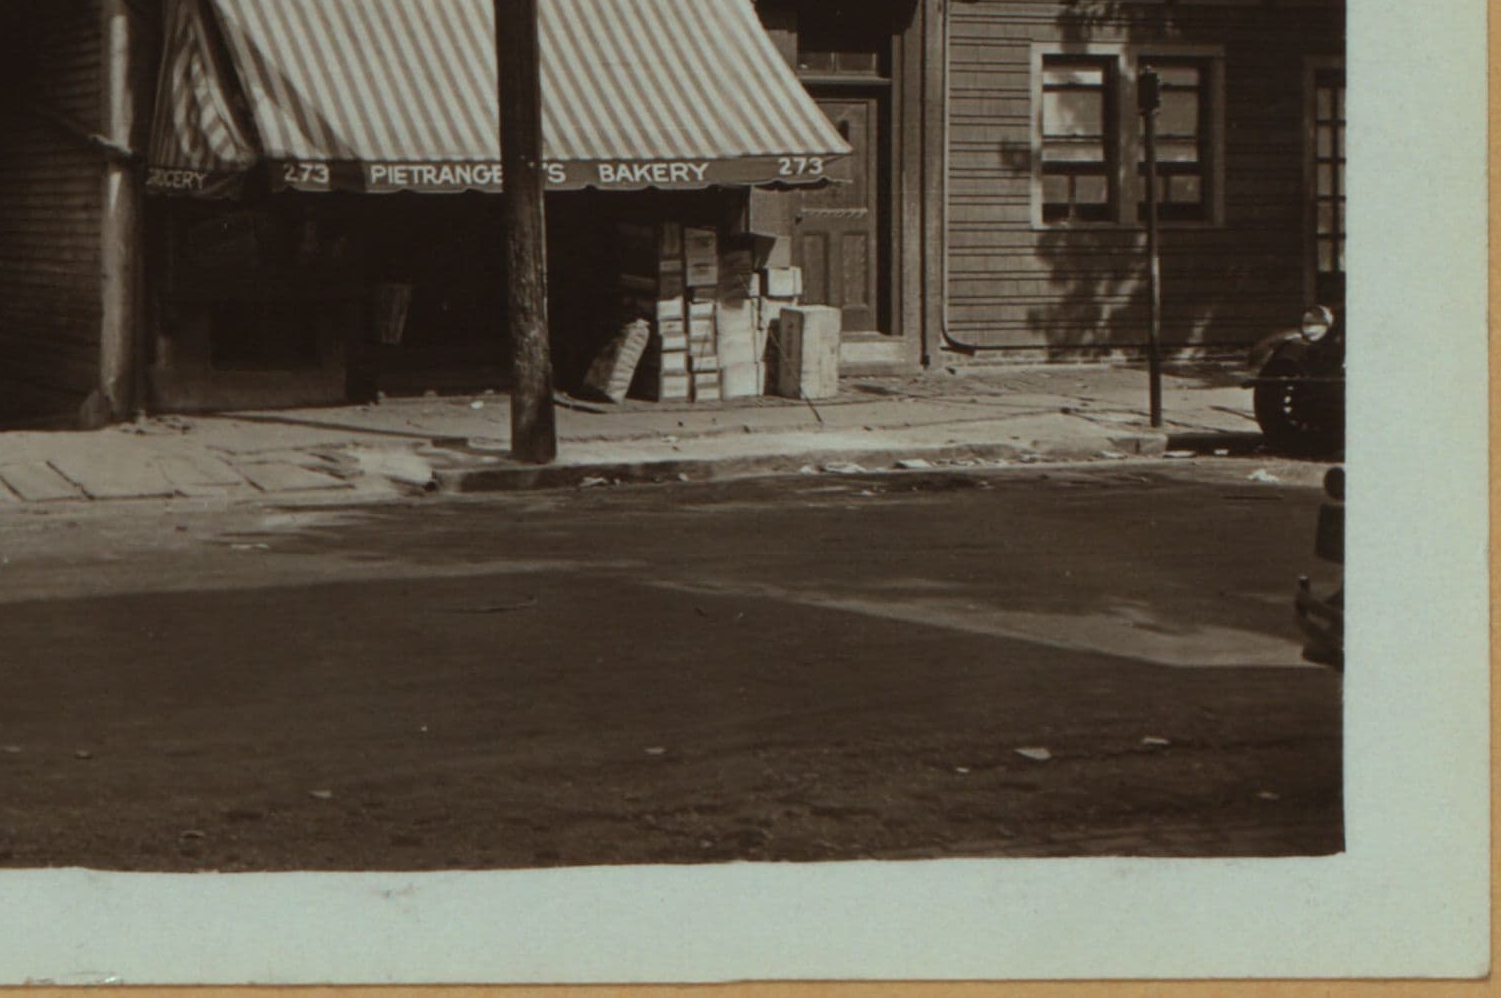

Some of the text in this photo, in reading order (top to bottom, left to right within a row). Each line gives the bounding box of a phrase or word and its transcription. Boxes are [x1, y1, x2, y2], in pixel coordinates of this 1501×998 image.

[283, 156, 824, 185] 273 PIETRANGE'S BAKERY 273
